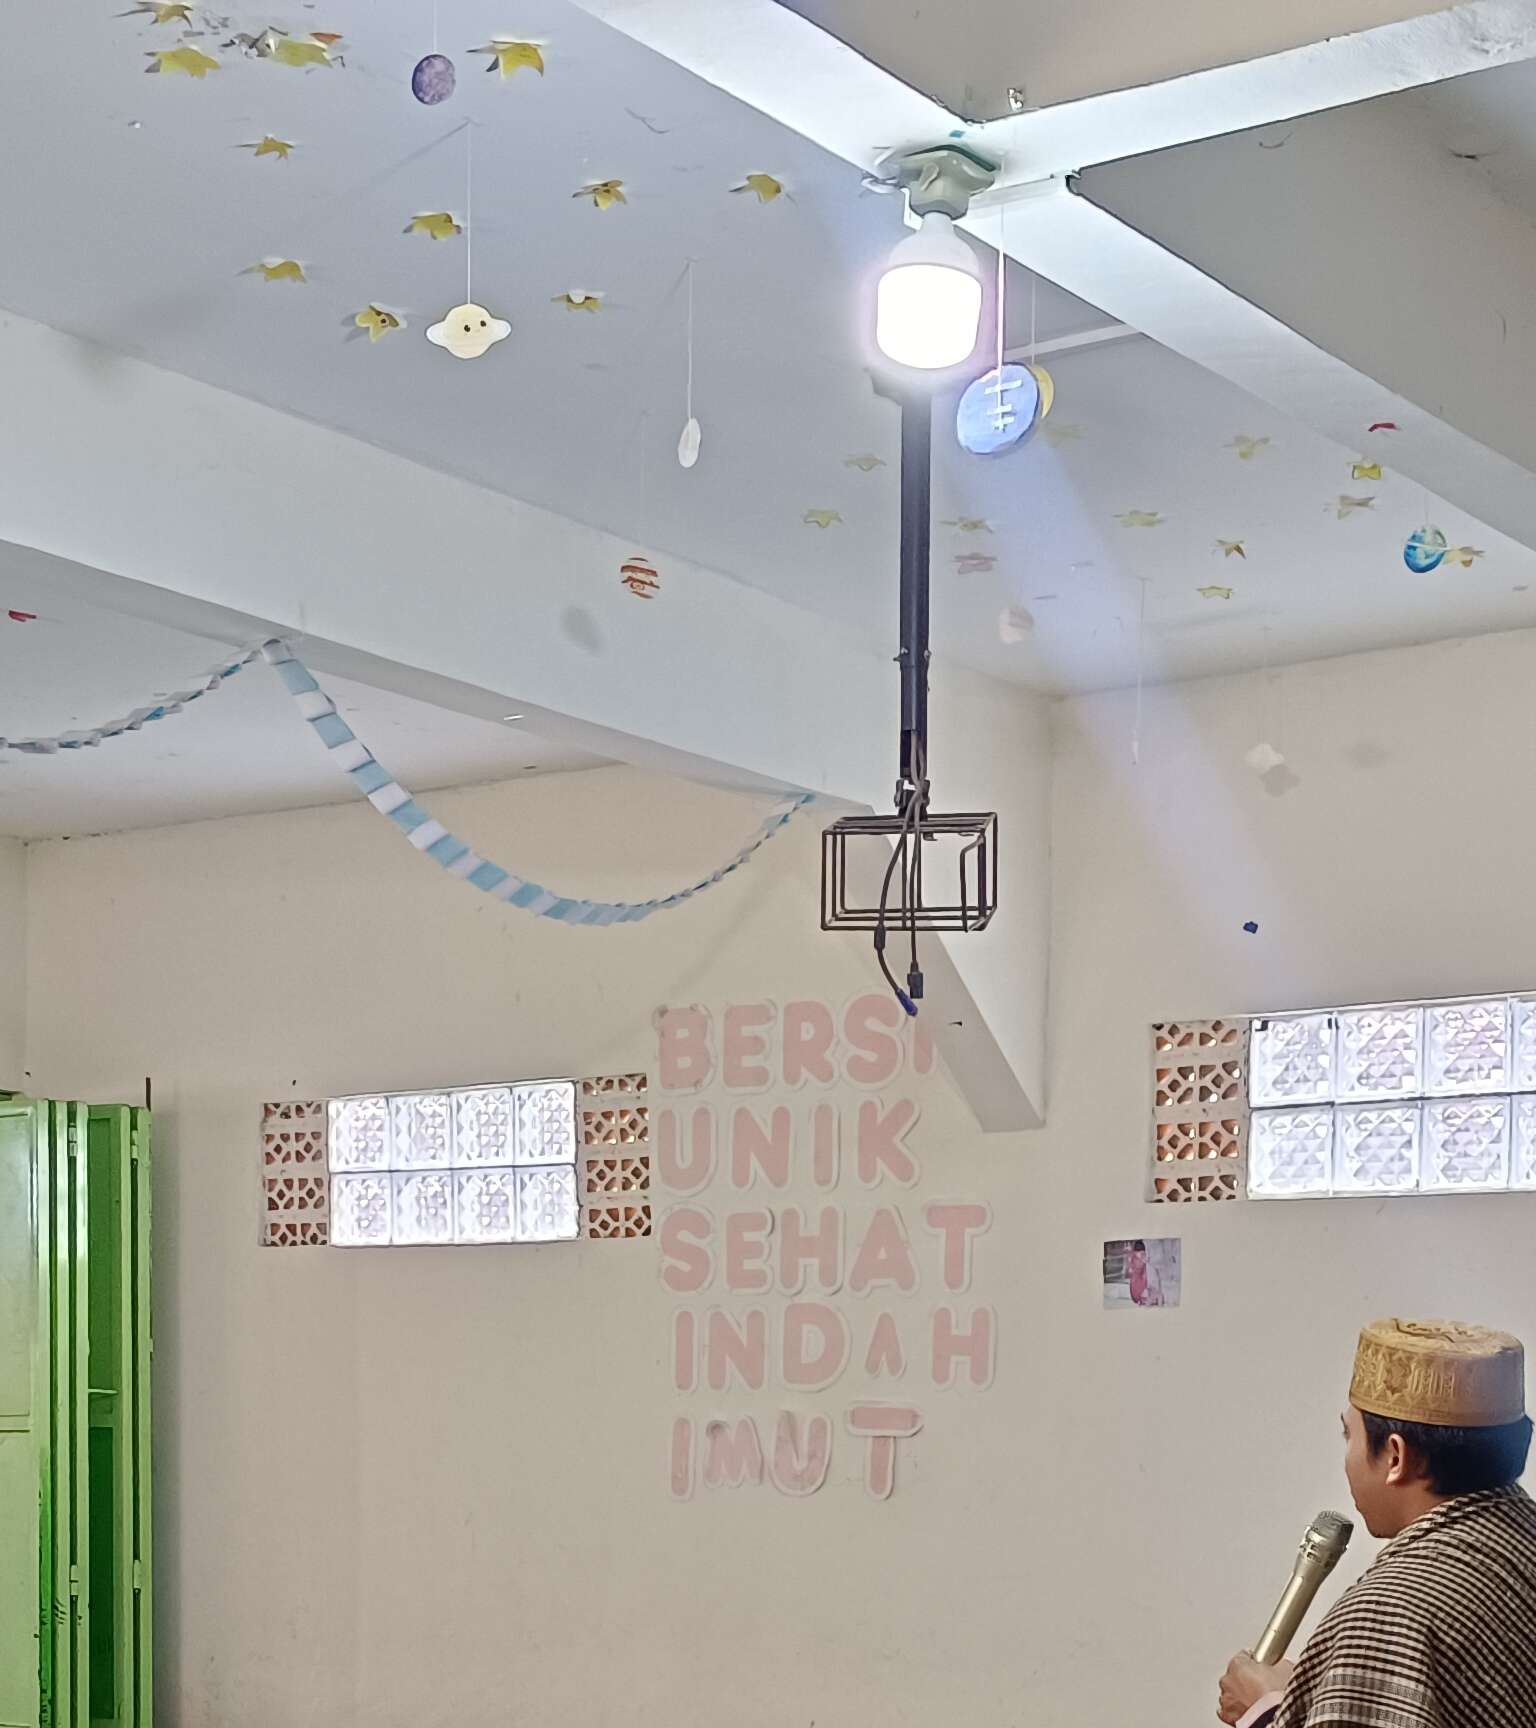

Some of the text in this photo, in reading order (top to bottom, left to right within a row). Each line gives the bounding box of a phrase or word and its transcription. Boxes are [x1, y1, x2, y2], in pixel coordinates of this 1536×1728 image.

[657, 1097, 920, 1194] UNIK
[659, 1203, 990, 1296] SEHAT
[673, 1301, 996, 1394] INDAH
[669, 1405, 924, 1499] IMUT
